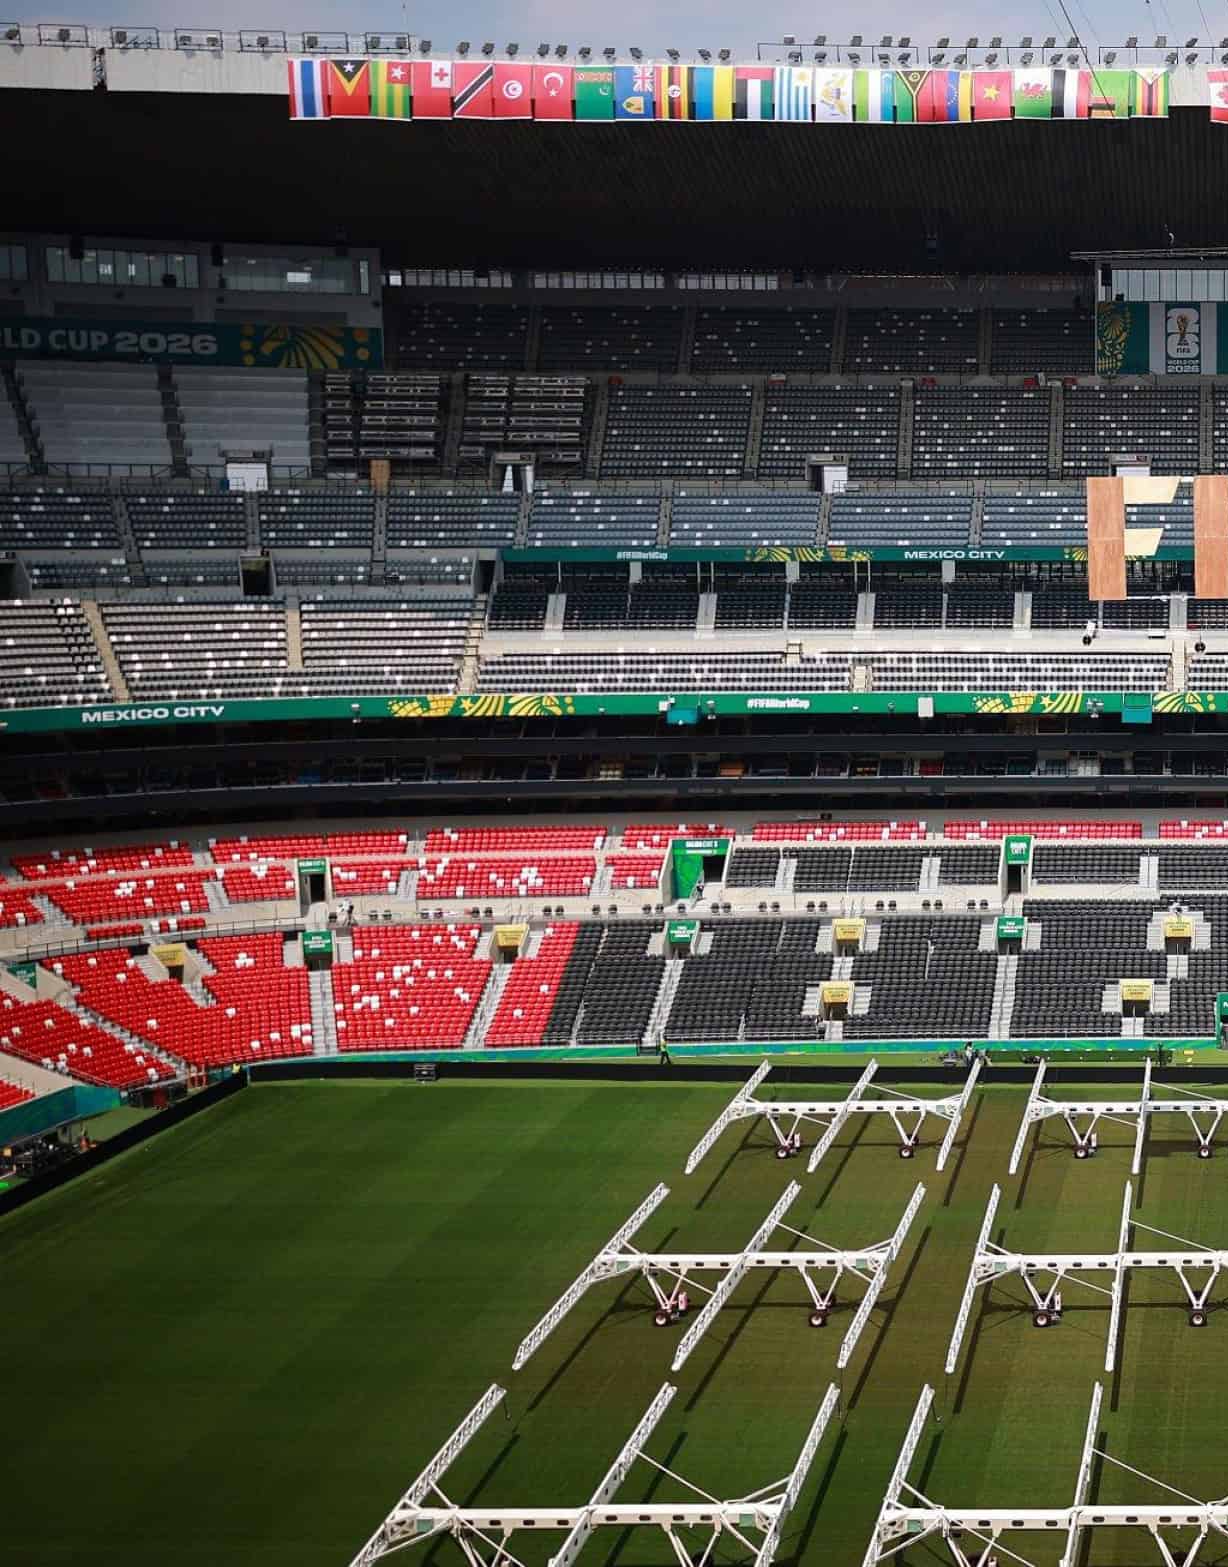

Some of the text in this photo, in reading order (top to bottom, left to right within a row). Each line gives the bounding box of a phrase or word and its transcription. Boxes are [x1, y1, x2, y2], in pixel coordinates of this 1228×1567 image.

[0, 327, 219, 355] LD CUP 2026
[904, 550, 1005, 559] MEXICO CITY
[81, 706, 225, 723] MEXICO CITY
